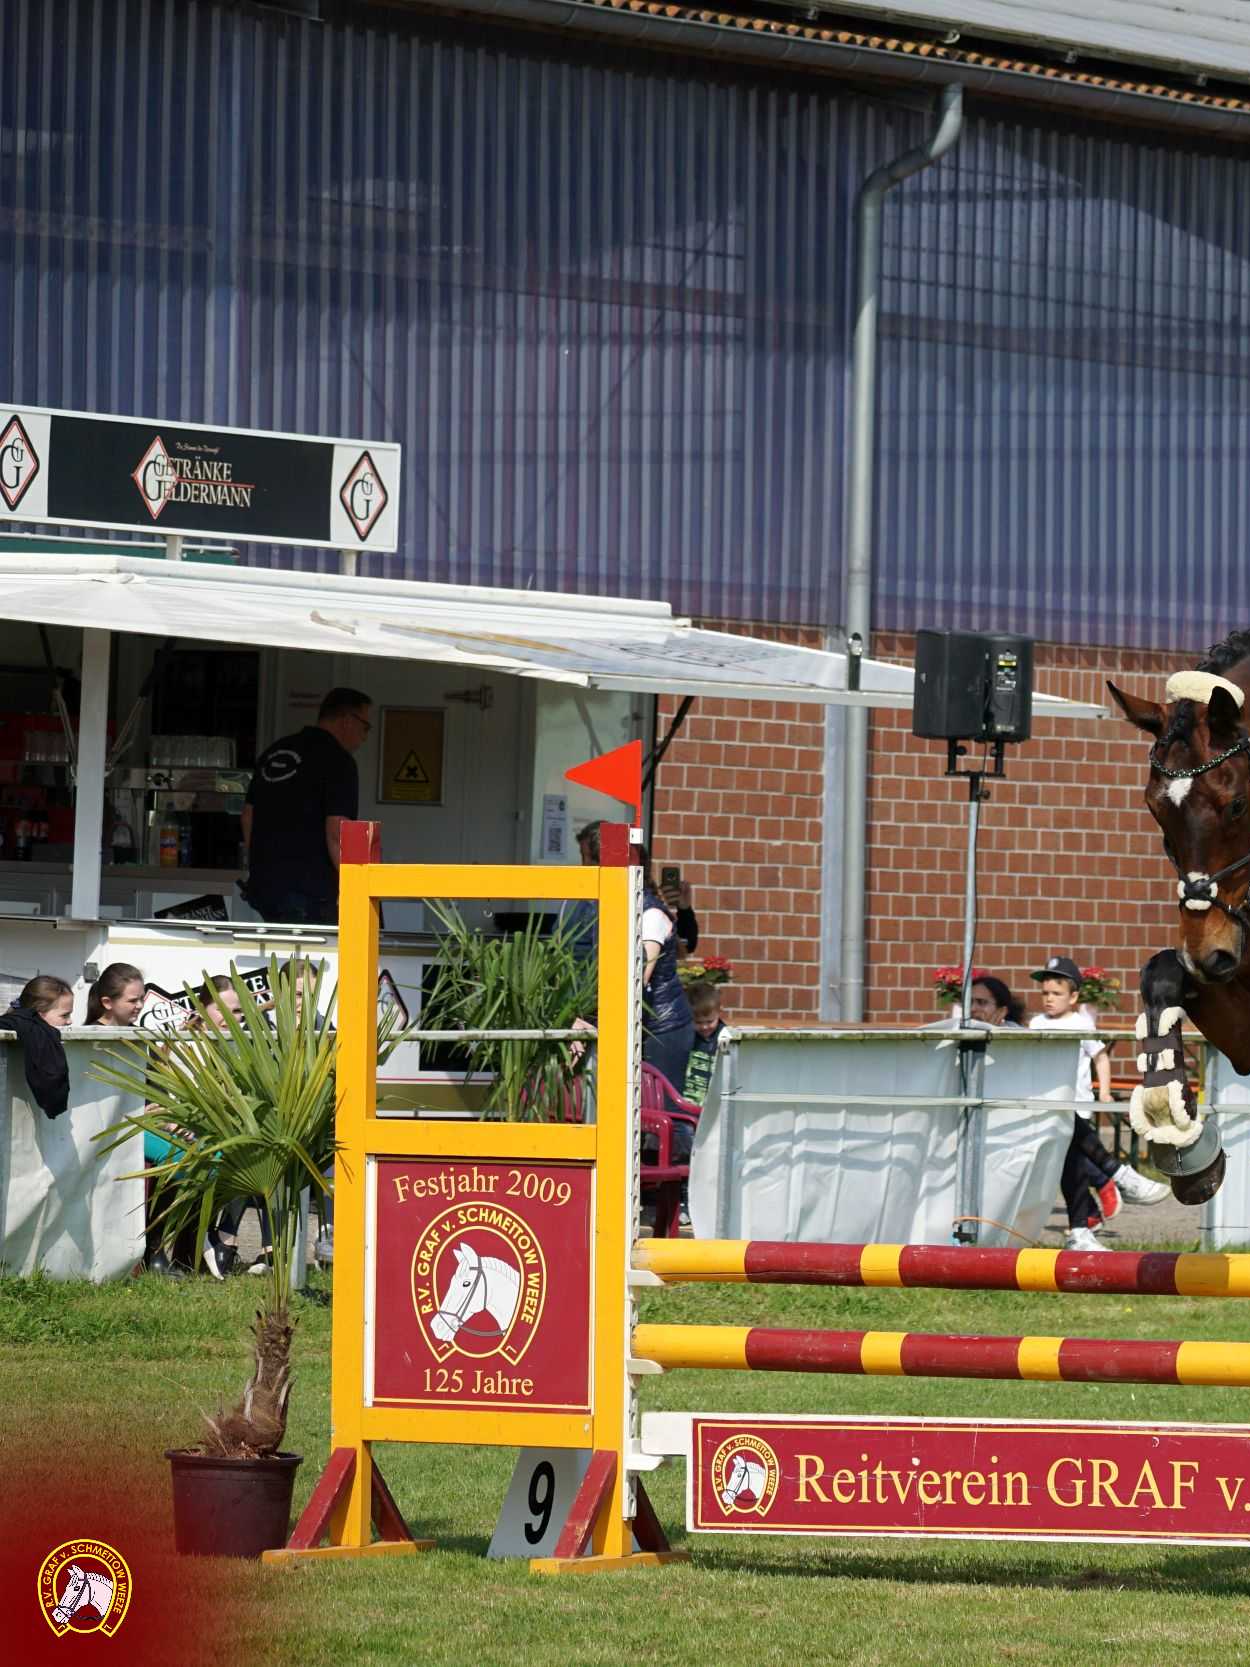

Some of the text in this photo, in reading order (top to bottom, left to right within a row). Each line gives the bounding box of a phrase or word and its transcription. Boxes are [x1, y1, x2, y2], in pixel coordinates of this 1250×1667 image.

[392, 1166, 572, 1207] Festjahr 2009
[417, 1228, 441, 1277] GRAF
[441, 1220, 456, 1232] v.
[457, 1207, 539, 1265] SCHMETTOW
[520, 1272, 541, 1325] WEEZE
[423, 1368, 534, 1396] 125 Jahre
[715, 1448, 727, 1472] GRAF
[734, 1437, 774, 1466] SCHMETTOW
[524, 1460, 555, 1545] 9
[794, 1453, 1032, 1506] Reitverein
[1047, 1457, 1199, 1509] GRAF
